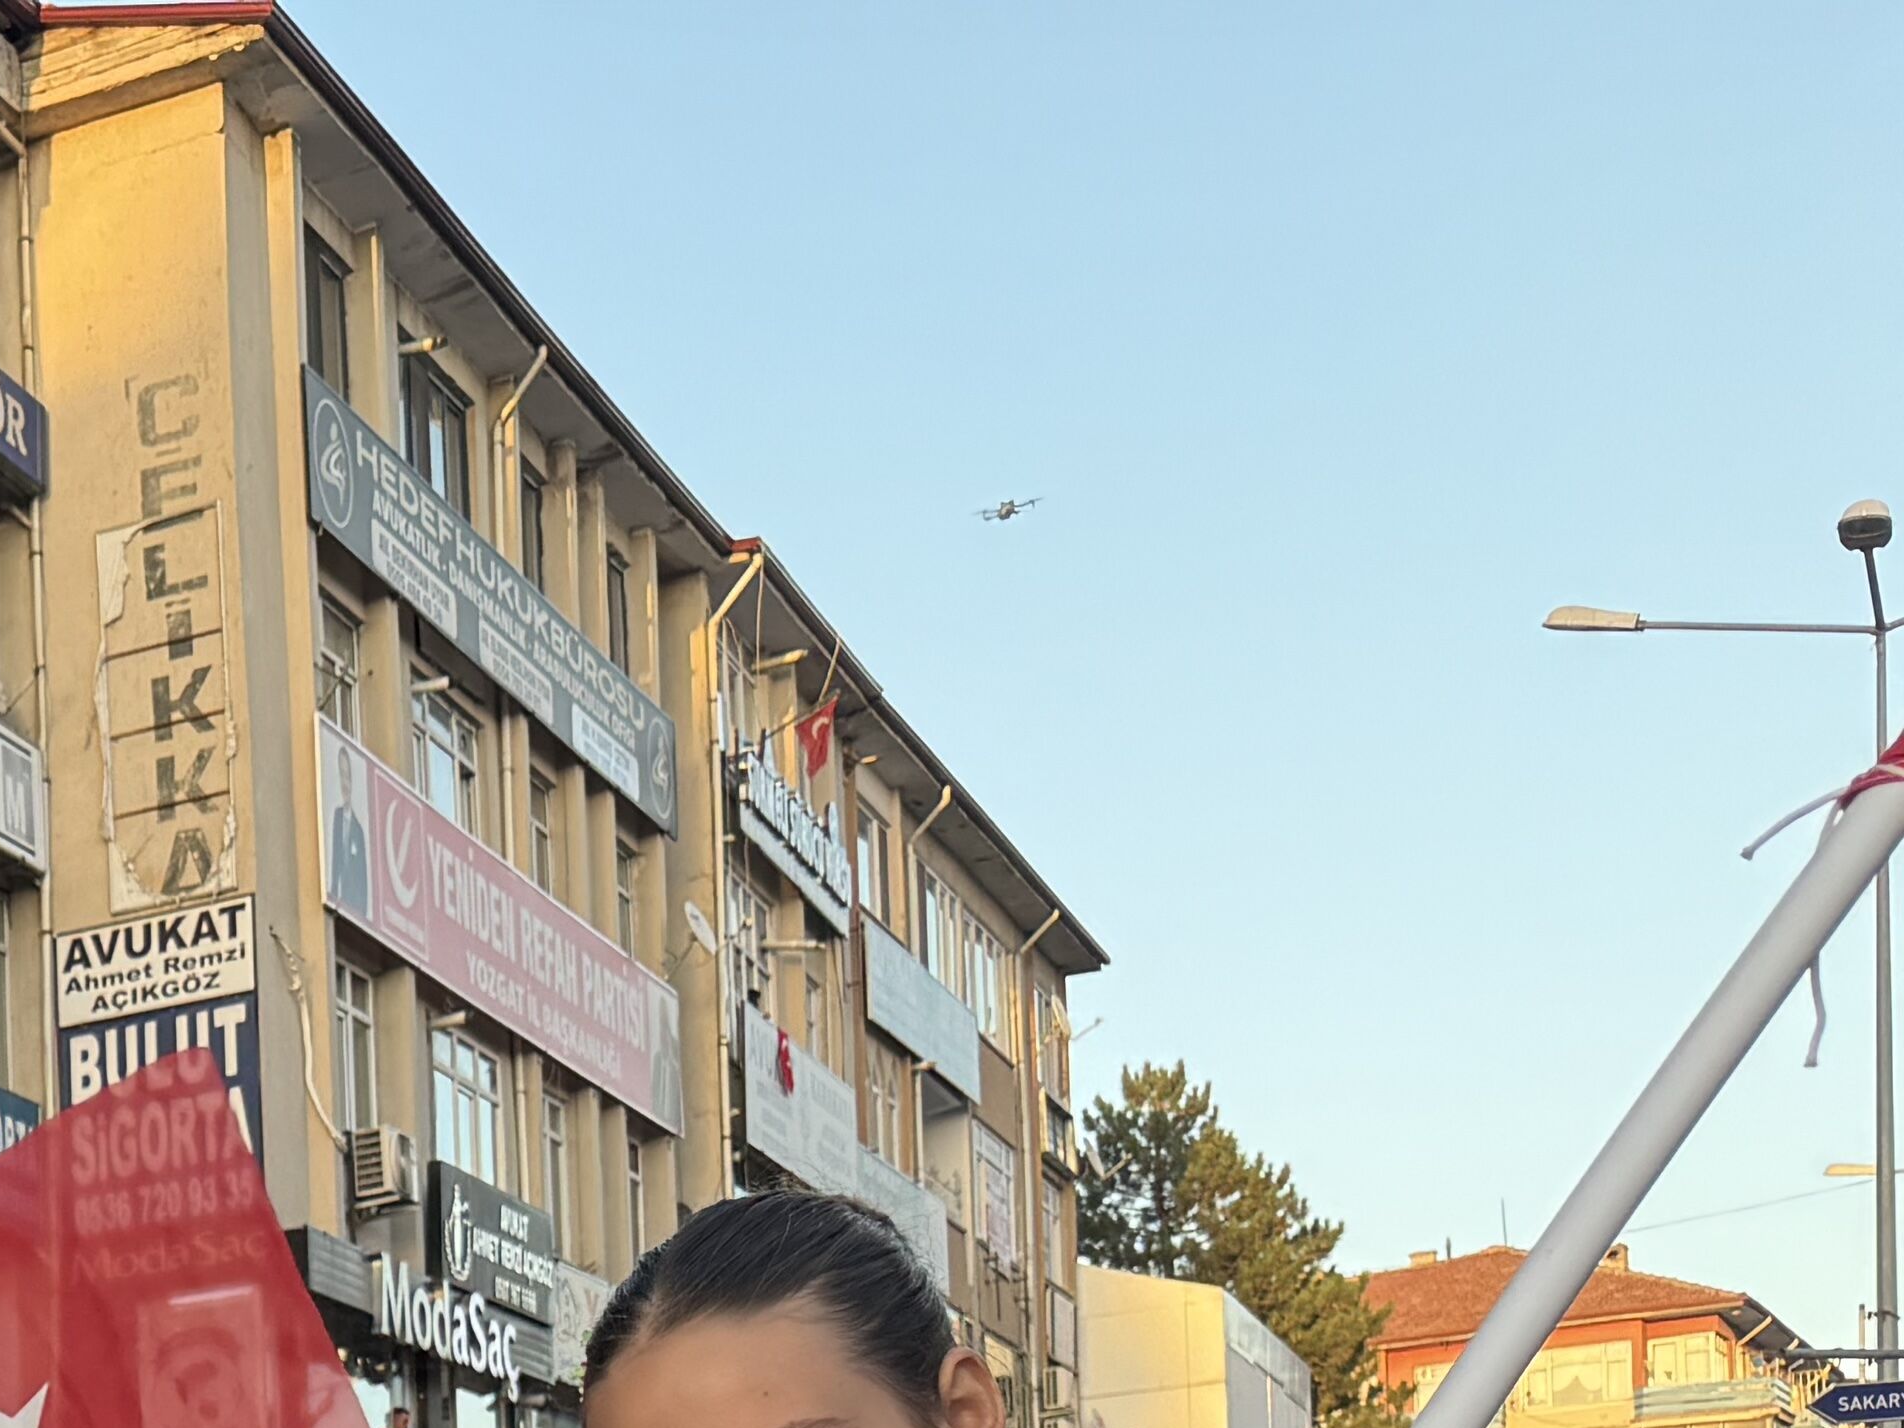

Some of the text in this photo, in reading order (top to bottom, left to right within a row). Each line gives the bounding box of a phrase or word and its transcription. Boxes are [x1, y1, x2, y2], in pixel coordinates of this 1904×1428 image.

[372, 489, 441, 572] AVUKATLIK
[356, 429, 454, 545] HEDEF
[454, 526, 550, 643] HUKUK
[549, 617, 646, 731] BÜROSU
[62, 902, 247, 974] AVUKAT
[65, 941, 247, 996] Ahmet Remzi
[427, 834, 517, 963] YENİDEN
[520, 906, 578, 1005] REFAH
[581, 950, 646, 1052] PARTİSİ
[91, 971, 222, 1014] AÇIKGÖZ
[465, 949, 524, 1016] YOZGAT
[69, 1003, 247, 1105] BULUT
[69, 1085, 254, 1186] SİGORTA
[381, 1251, 519, 1403] ModaSaç
[1838, 1392, 1904, 1412] SAKAR
